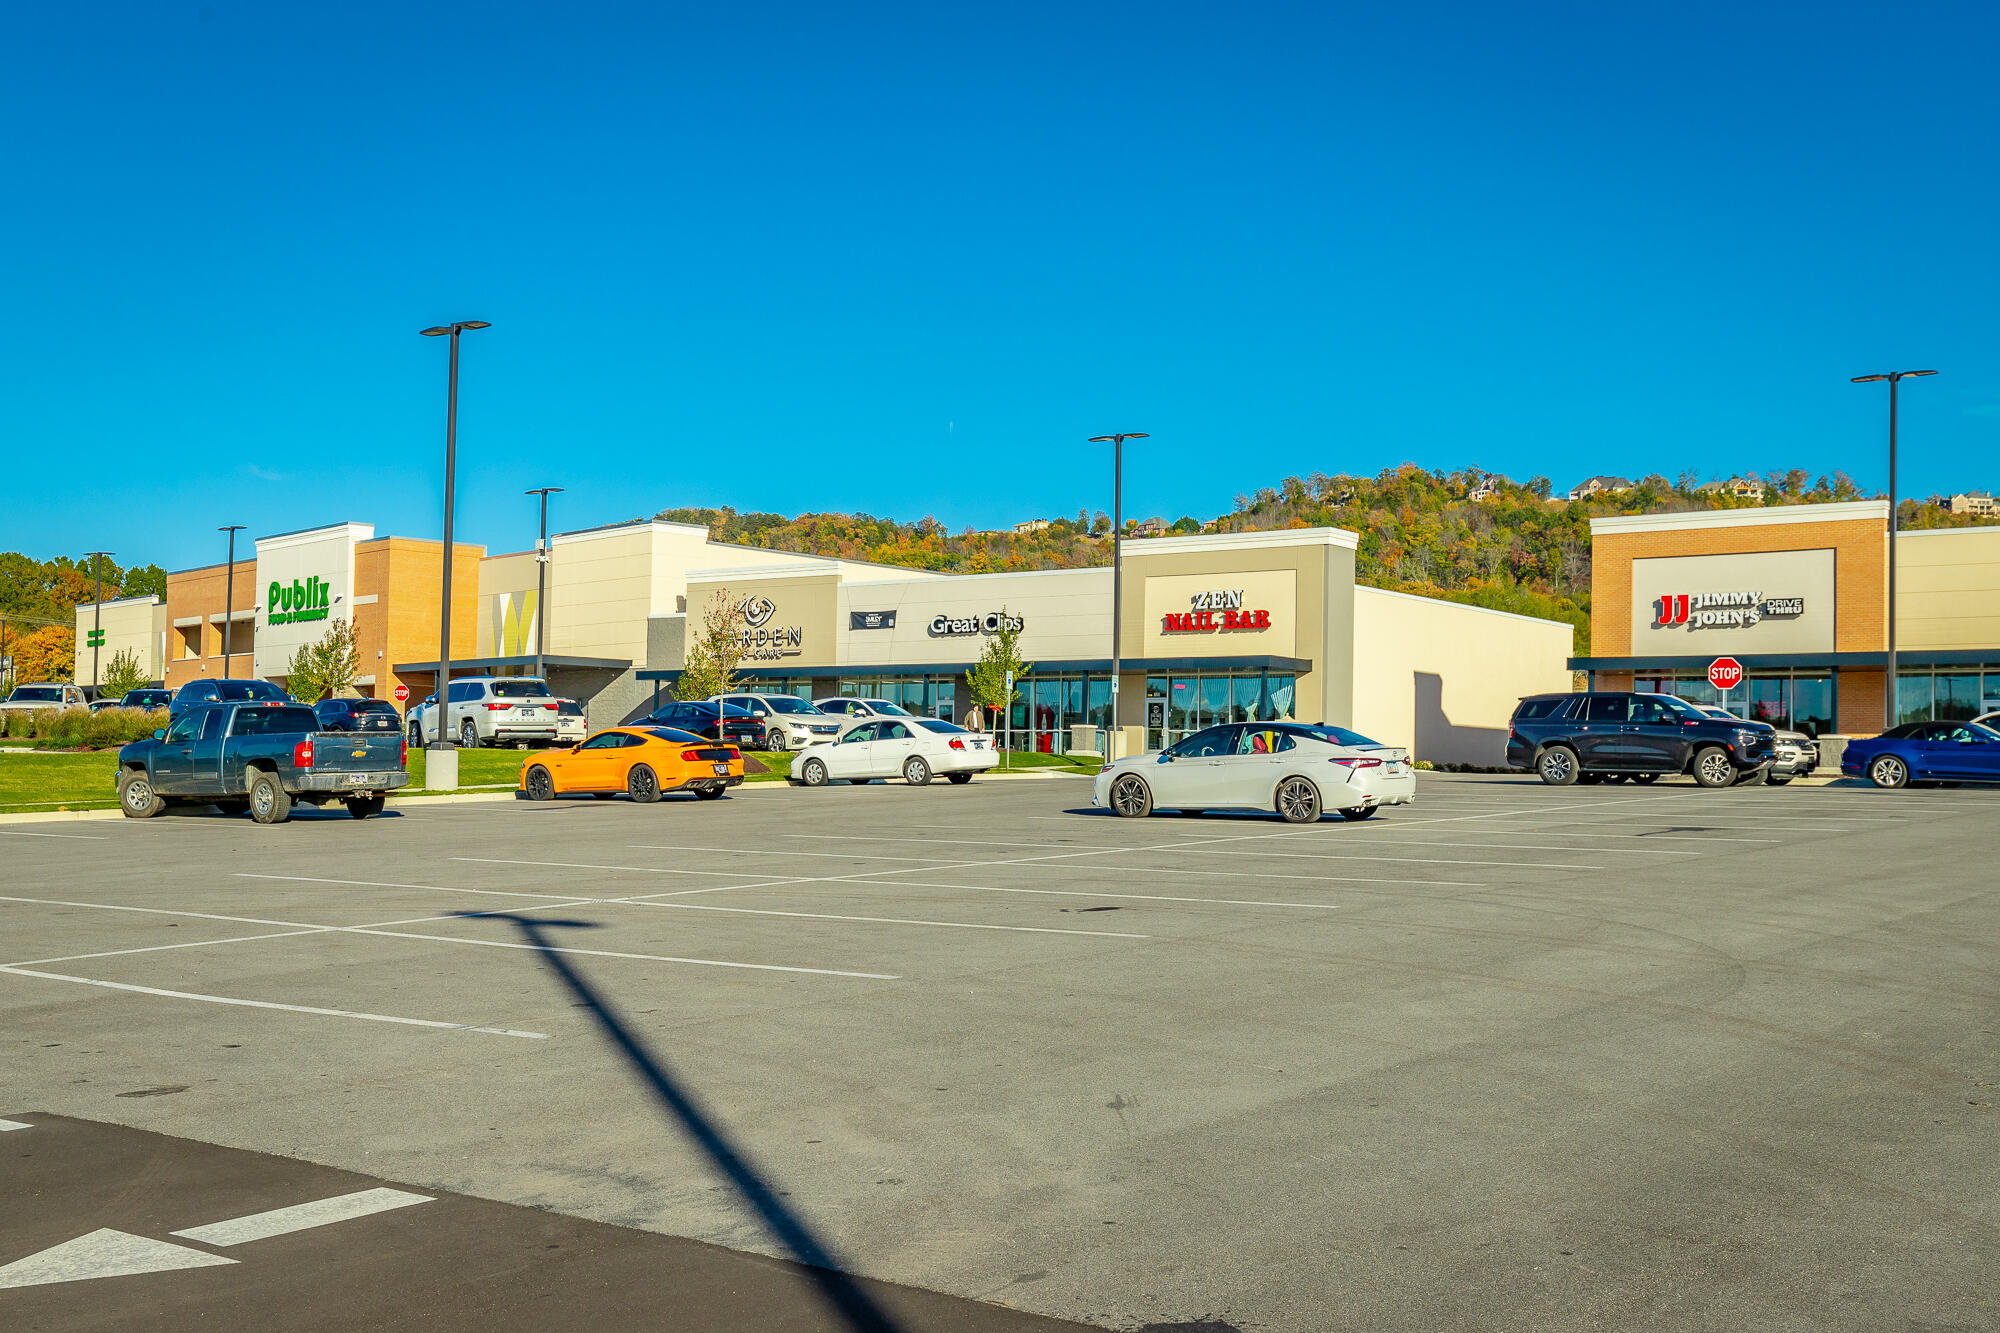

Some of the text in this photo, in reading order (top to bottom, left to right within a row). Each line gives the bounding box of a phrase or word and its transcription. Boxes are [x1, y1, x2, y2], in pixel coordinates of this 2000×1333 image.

[268, 575, 330, 613] Publix
[1195, 590, 1242, 609] ZEN
[1695, 591, 1763, 608] JIMMY
[1658, 594, 1691, 625] JJ
[1767, 599, 1802, 607] DRIVE
[1767, 606, 1802, 614] THRU
[930, 615, 978, 634] Great
[1165, 610, 1271, 631] NAIL BAR
[1694, 610, 1762, 627] JOHN'S
[714, 627, 801, 646] ARDEN
[754, 648, 783, 659] CARE
[1711, 667, 1740, 680] STOP
[395, 689, 408, 697] STOP
